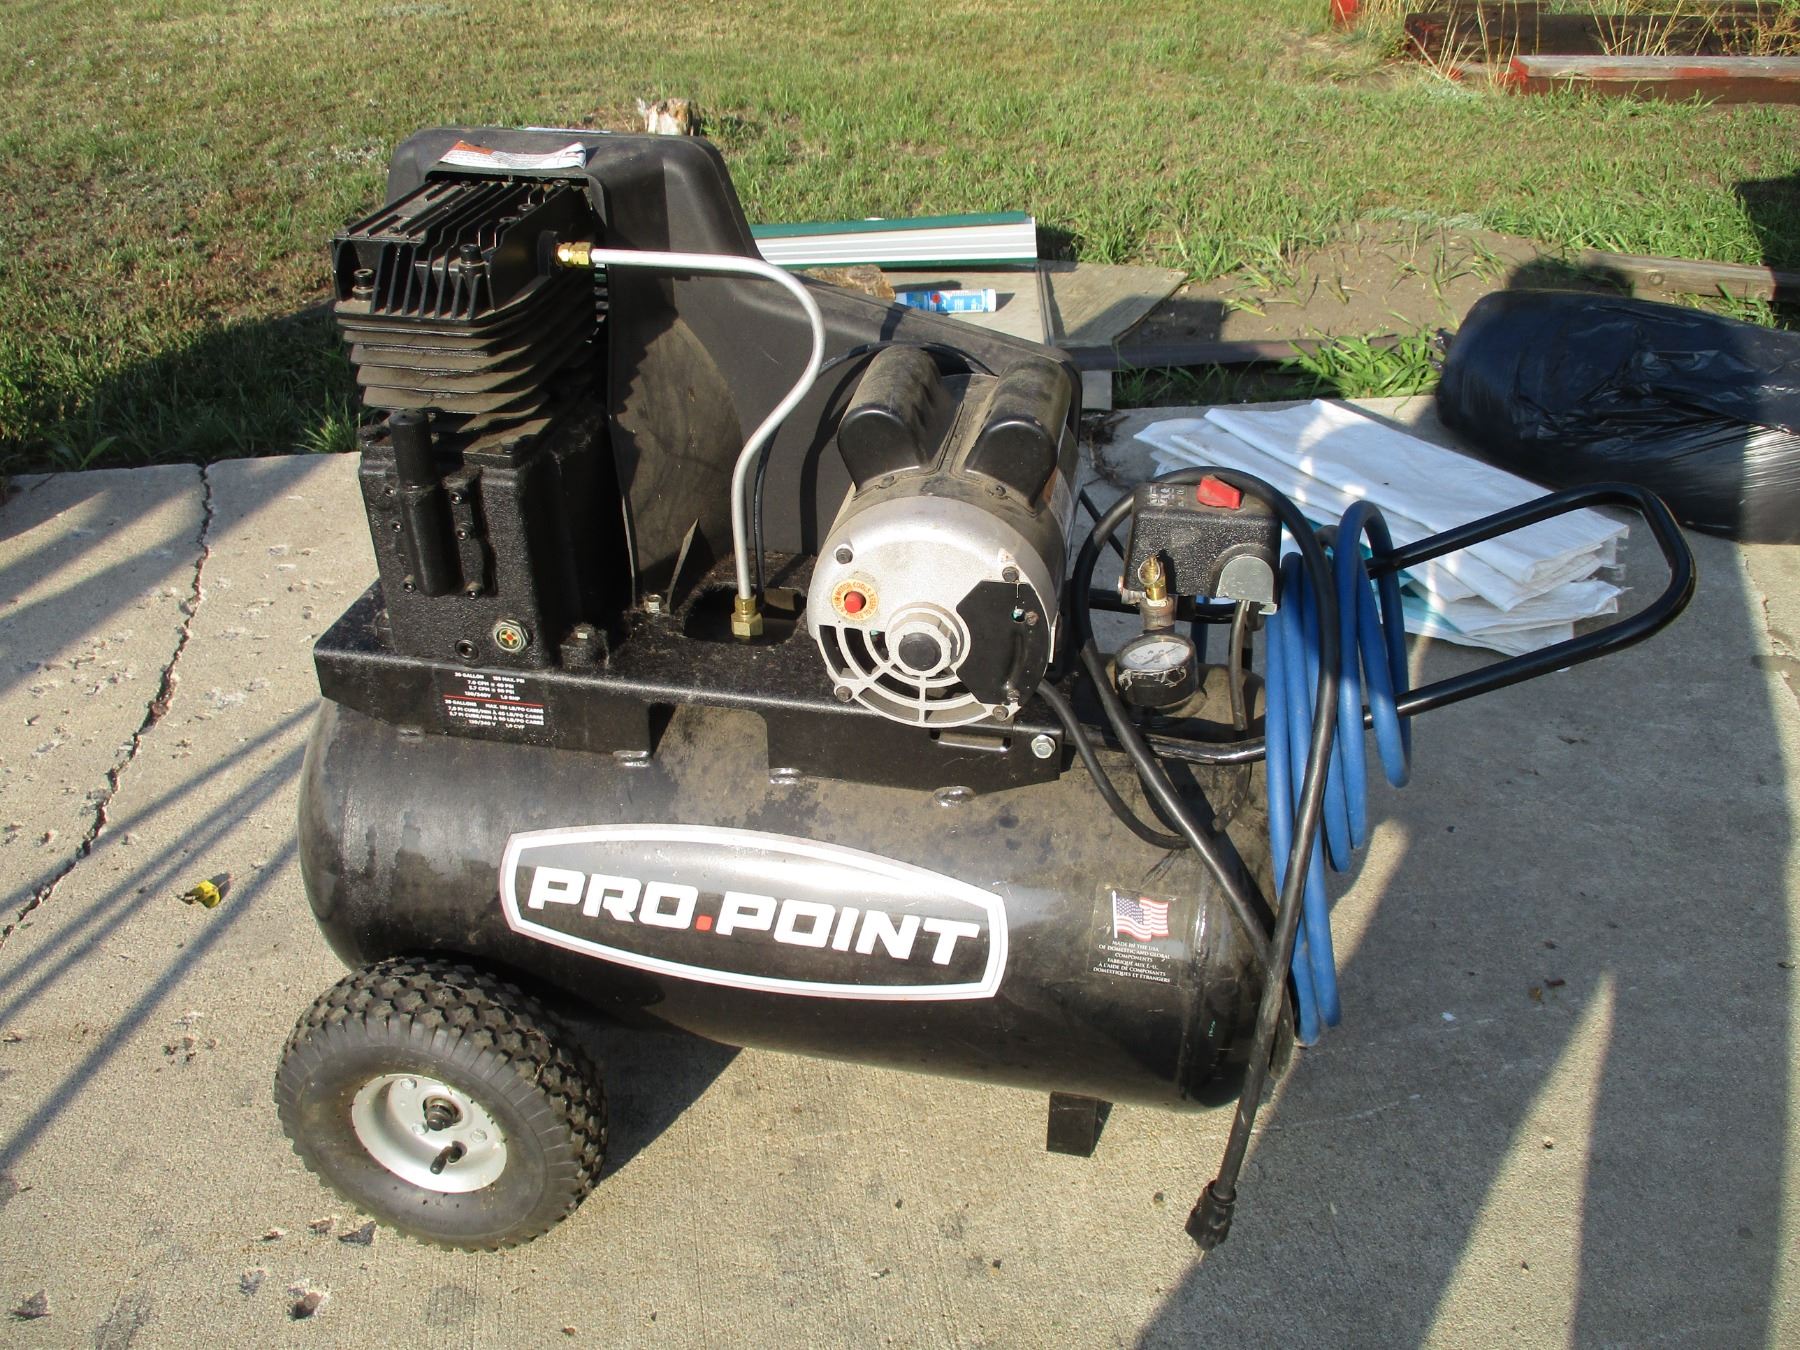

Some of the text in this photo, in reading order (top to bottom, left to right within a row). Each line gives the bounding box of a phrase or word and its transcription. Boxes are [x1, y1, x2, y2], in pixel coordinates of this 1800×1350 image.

[528, 866, 980, 966] PRO.POINT
[1107, 945, 1136, 954] DOMESTIC
[1107, 958, 1133, 966] FABRIQUÉ
[1115, 953, 1153, 962] COMPONENTS
[1093, 967, 1131, 976] DOMESTIQUES
[1129, 967, 1166, 976] COMPOSANTS
